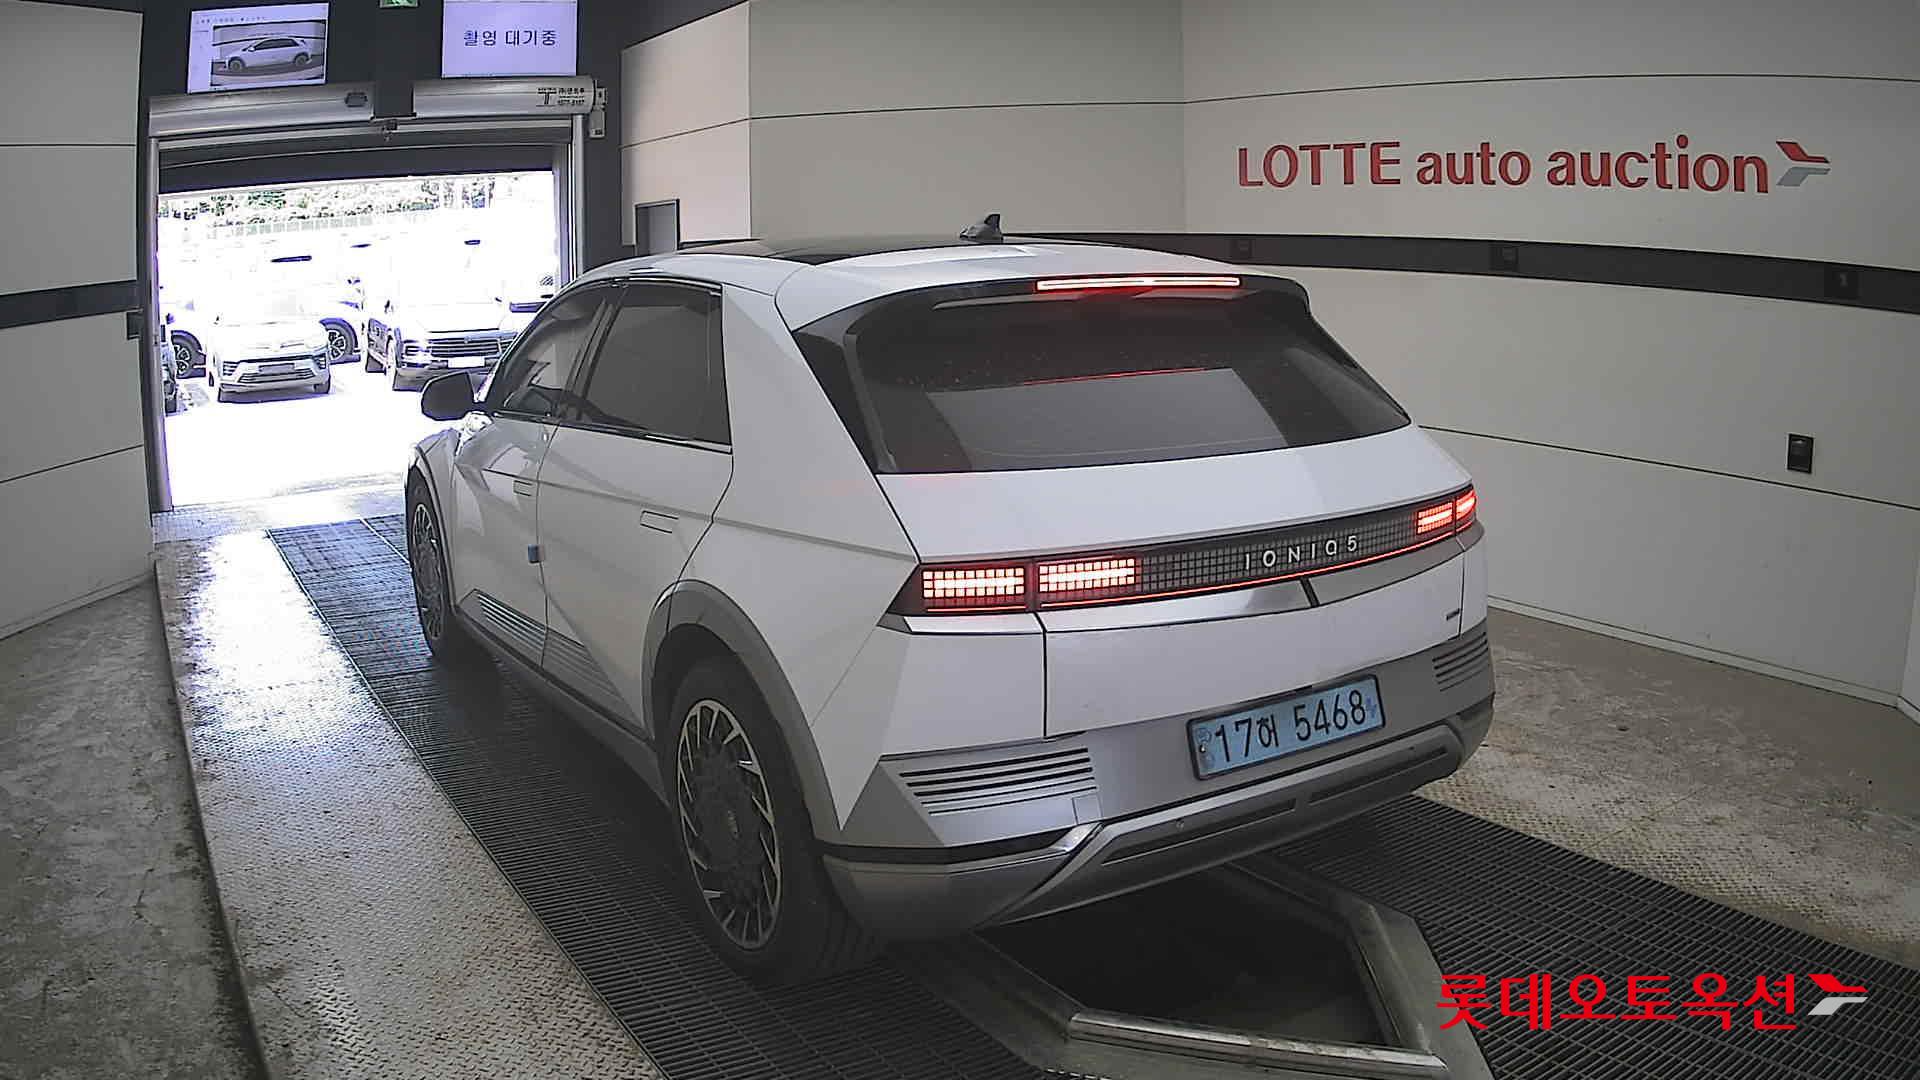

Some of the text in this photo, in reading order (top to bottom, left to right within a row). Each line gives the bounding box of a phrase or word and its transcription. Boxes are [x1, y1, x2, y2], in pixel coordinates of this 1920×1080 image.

[463, 29, 556, 47] 촬영 대기중
[1238, 134, 1769, 193] LOTTE auto auction
[1214, 689, 1367, 763] 17허 5468
